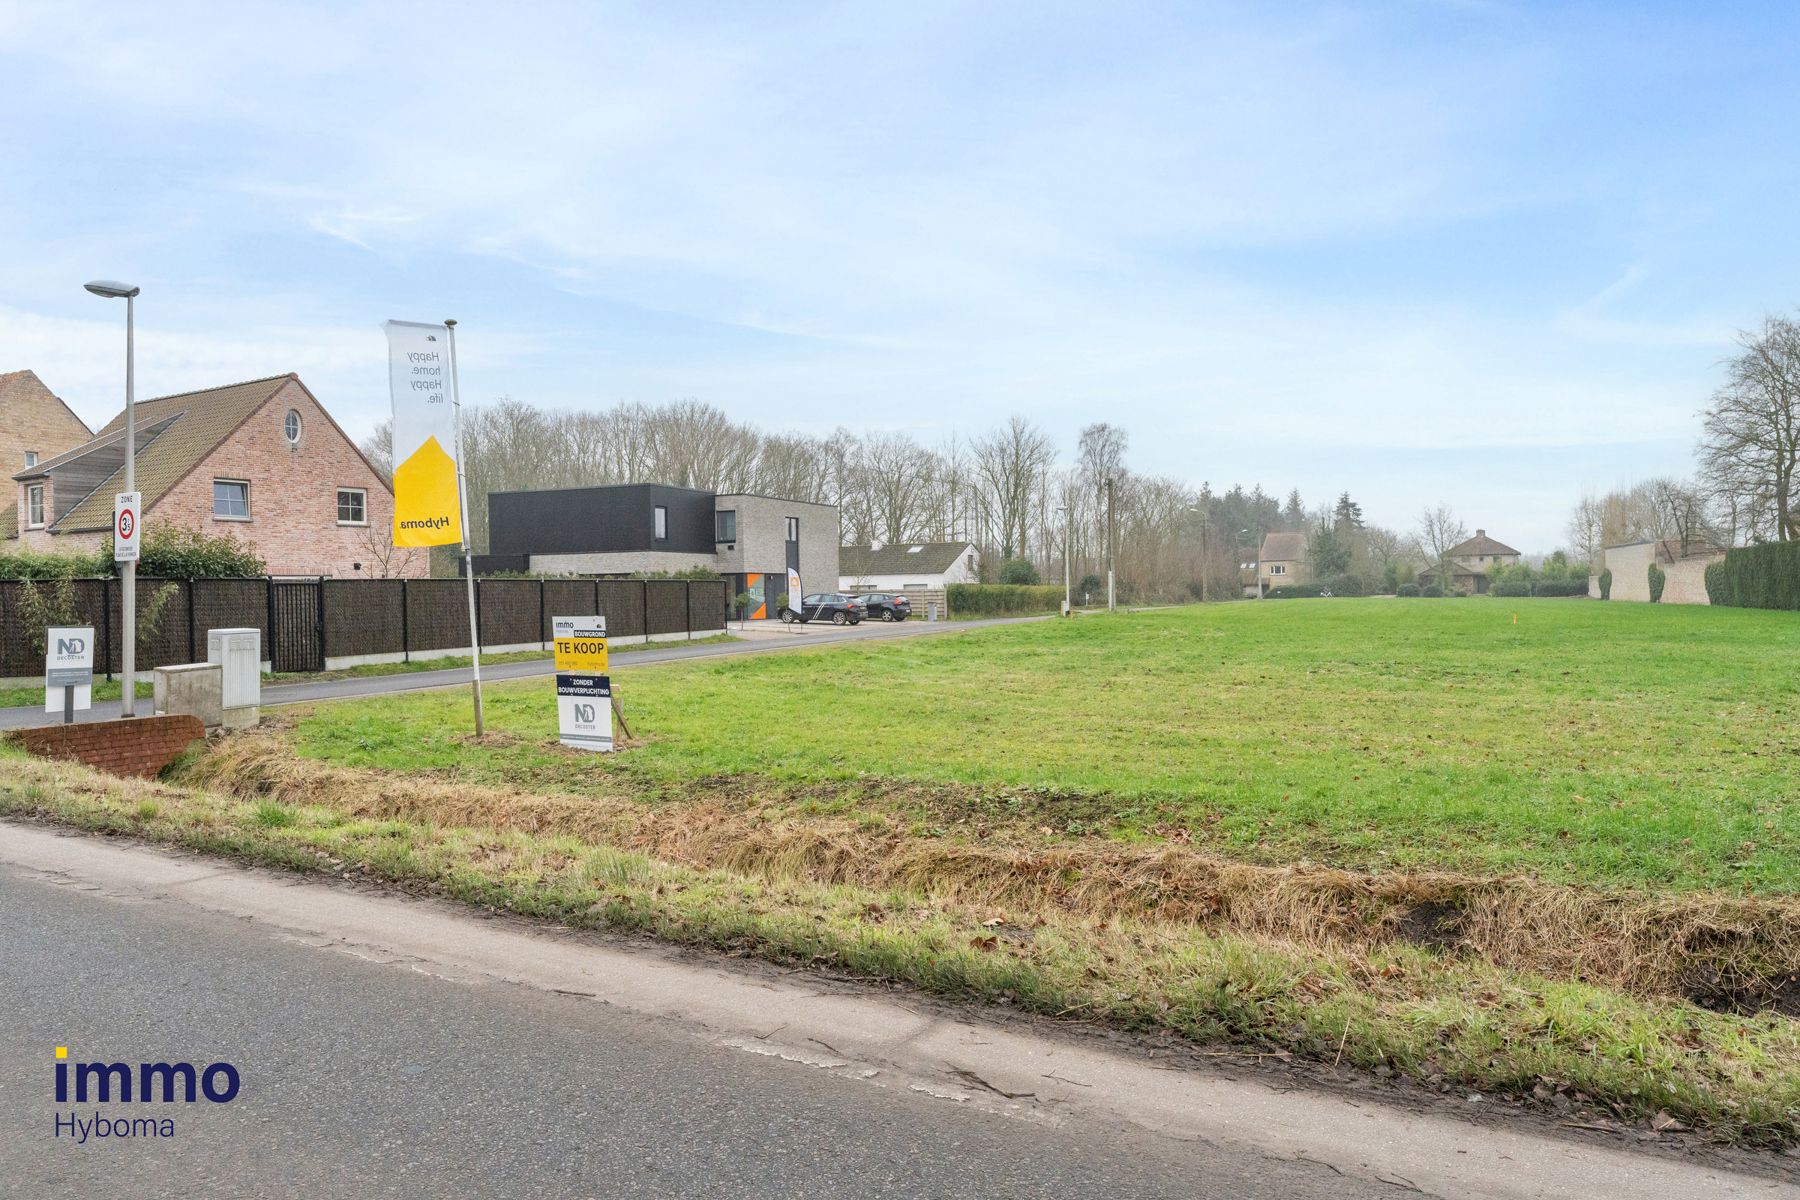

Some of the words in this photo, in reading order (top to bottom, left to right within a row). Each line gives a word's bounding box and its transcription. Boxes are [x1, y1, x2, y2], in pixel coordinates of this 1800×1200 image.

[120, 495, 133, 503] ZONE
[555, 621, 574, 629] immo
[57, 638, 85, 655] ND
[557, 642, 571, 654] TE
[573, 642, 605, 655] KOOP
[558, 687, 610, 695] BOUWVERPLICHTING
[574, 703, 596, 723] ND
